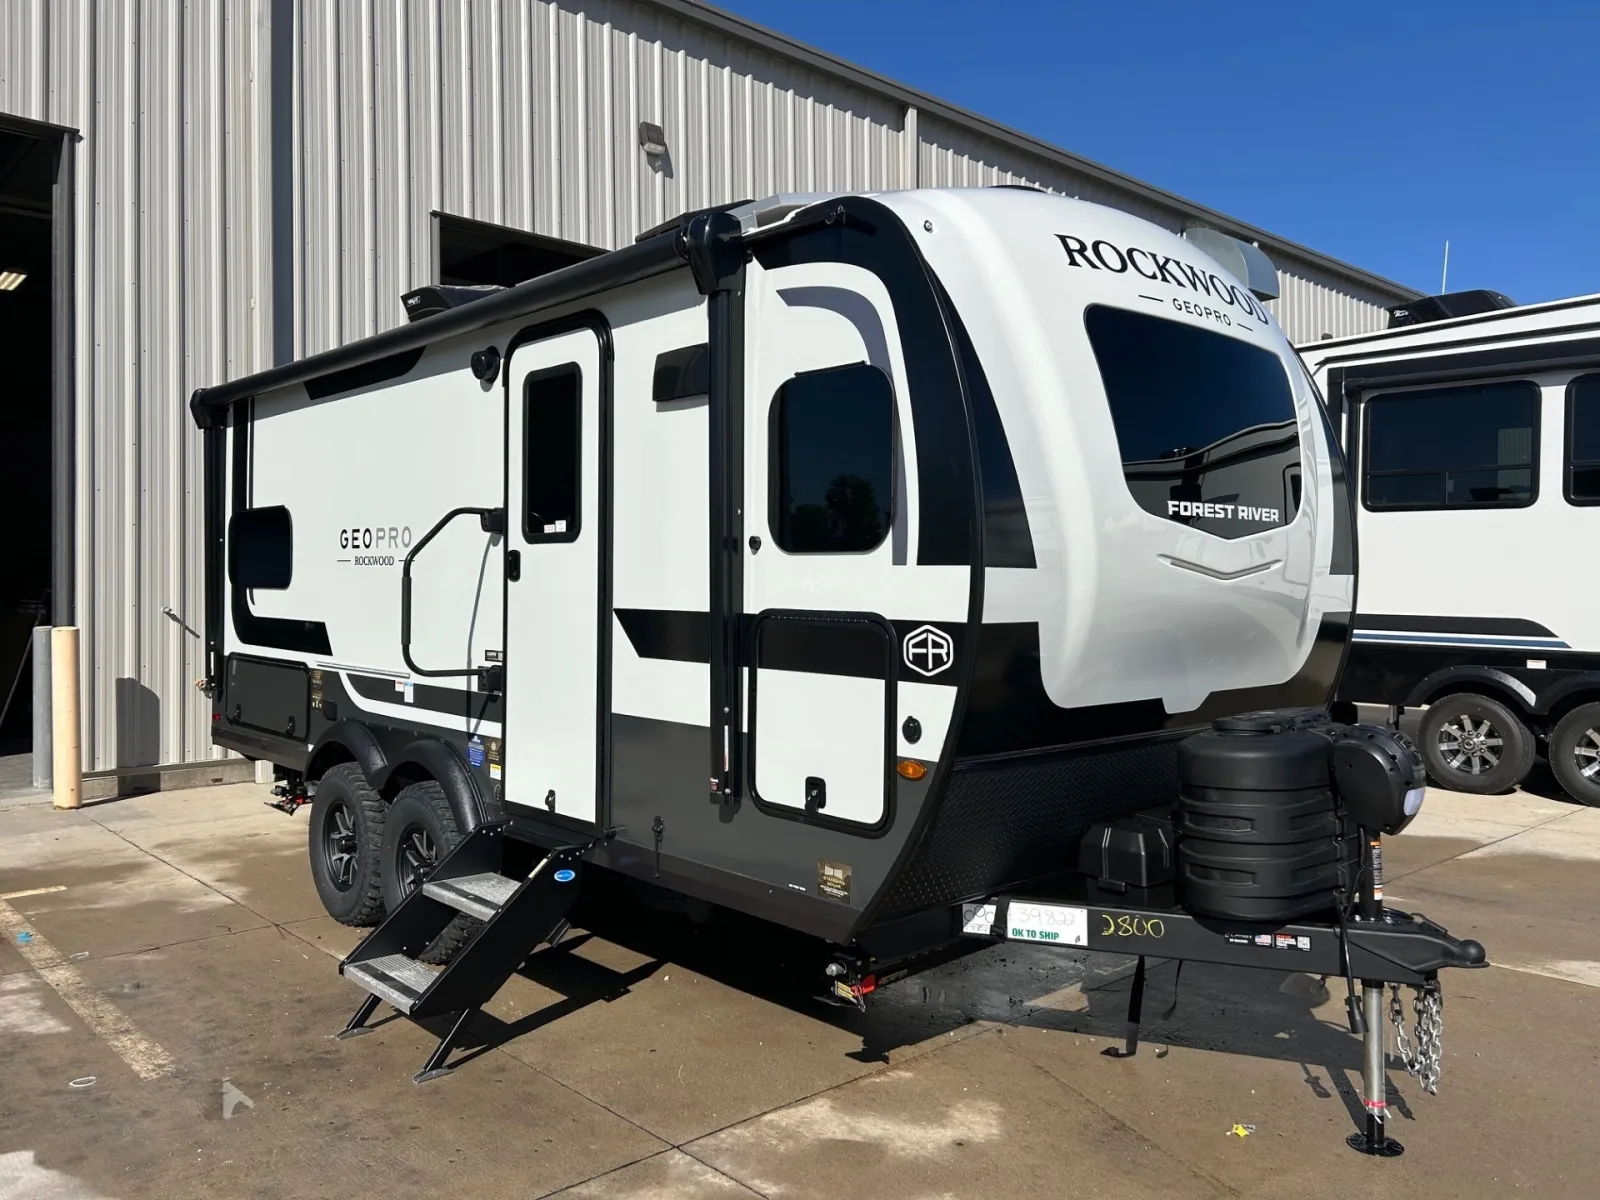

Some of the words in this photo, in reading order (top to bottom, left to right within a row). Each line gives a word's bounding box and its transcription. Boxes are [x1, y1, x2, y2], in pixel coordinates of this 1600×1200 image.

[1053, 234, 1269, 326] ROCKWOOD
[1172, 297, 1232, 327] GEOPRO
[1167, 500, 1235, 519] FOREST
[1237, 505, 1279, 522] RIVER
[339, 525, 412, 549] GEOPRO
[354, 555, 395, 566] ROCKWOOD
[1012, 927, 1024, 938] OK
[1026, 929, 1037, 939] TO
[1039, 930, 1060, 941] SHIP
[1101, 914, 1165, 938] 2800
